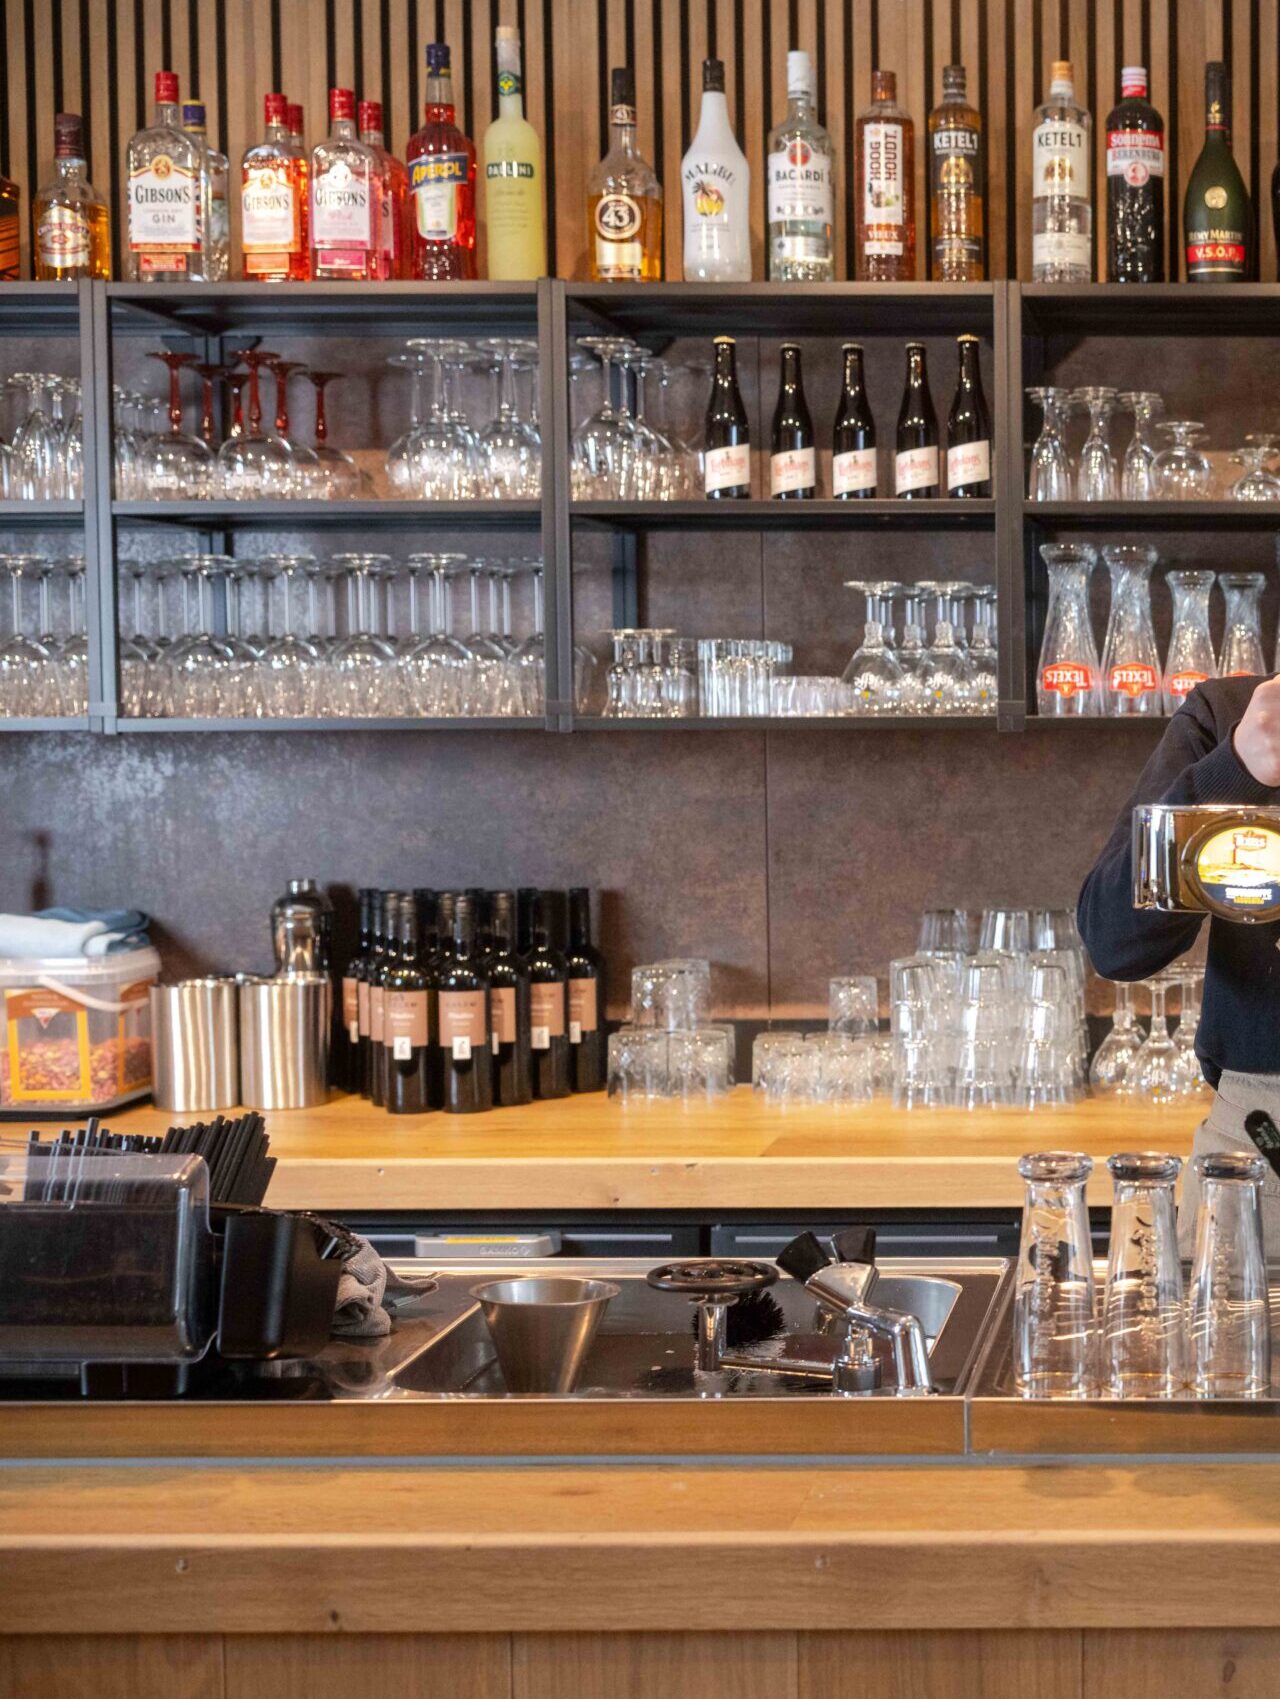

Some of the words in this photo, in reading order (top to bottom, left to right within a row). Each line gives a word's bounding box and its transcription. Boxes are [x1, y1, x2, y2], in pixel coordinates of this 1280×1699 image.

[412, 161, 463, 186] APEROL
[488, 166, 531, 178] PALNI
[152, 213, 176, 224] GIN
[601, 206, 630, 228] 43
[1209, 229, 1242, 241] MARTIN
